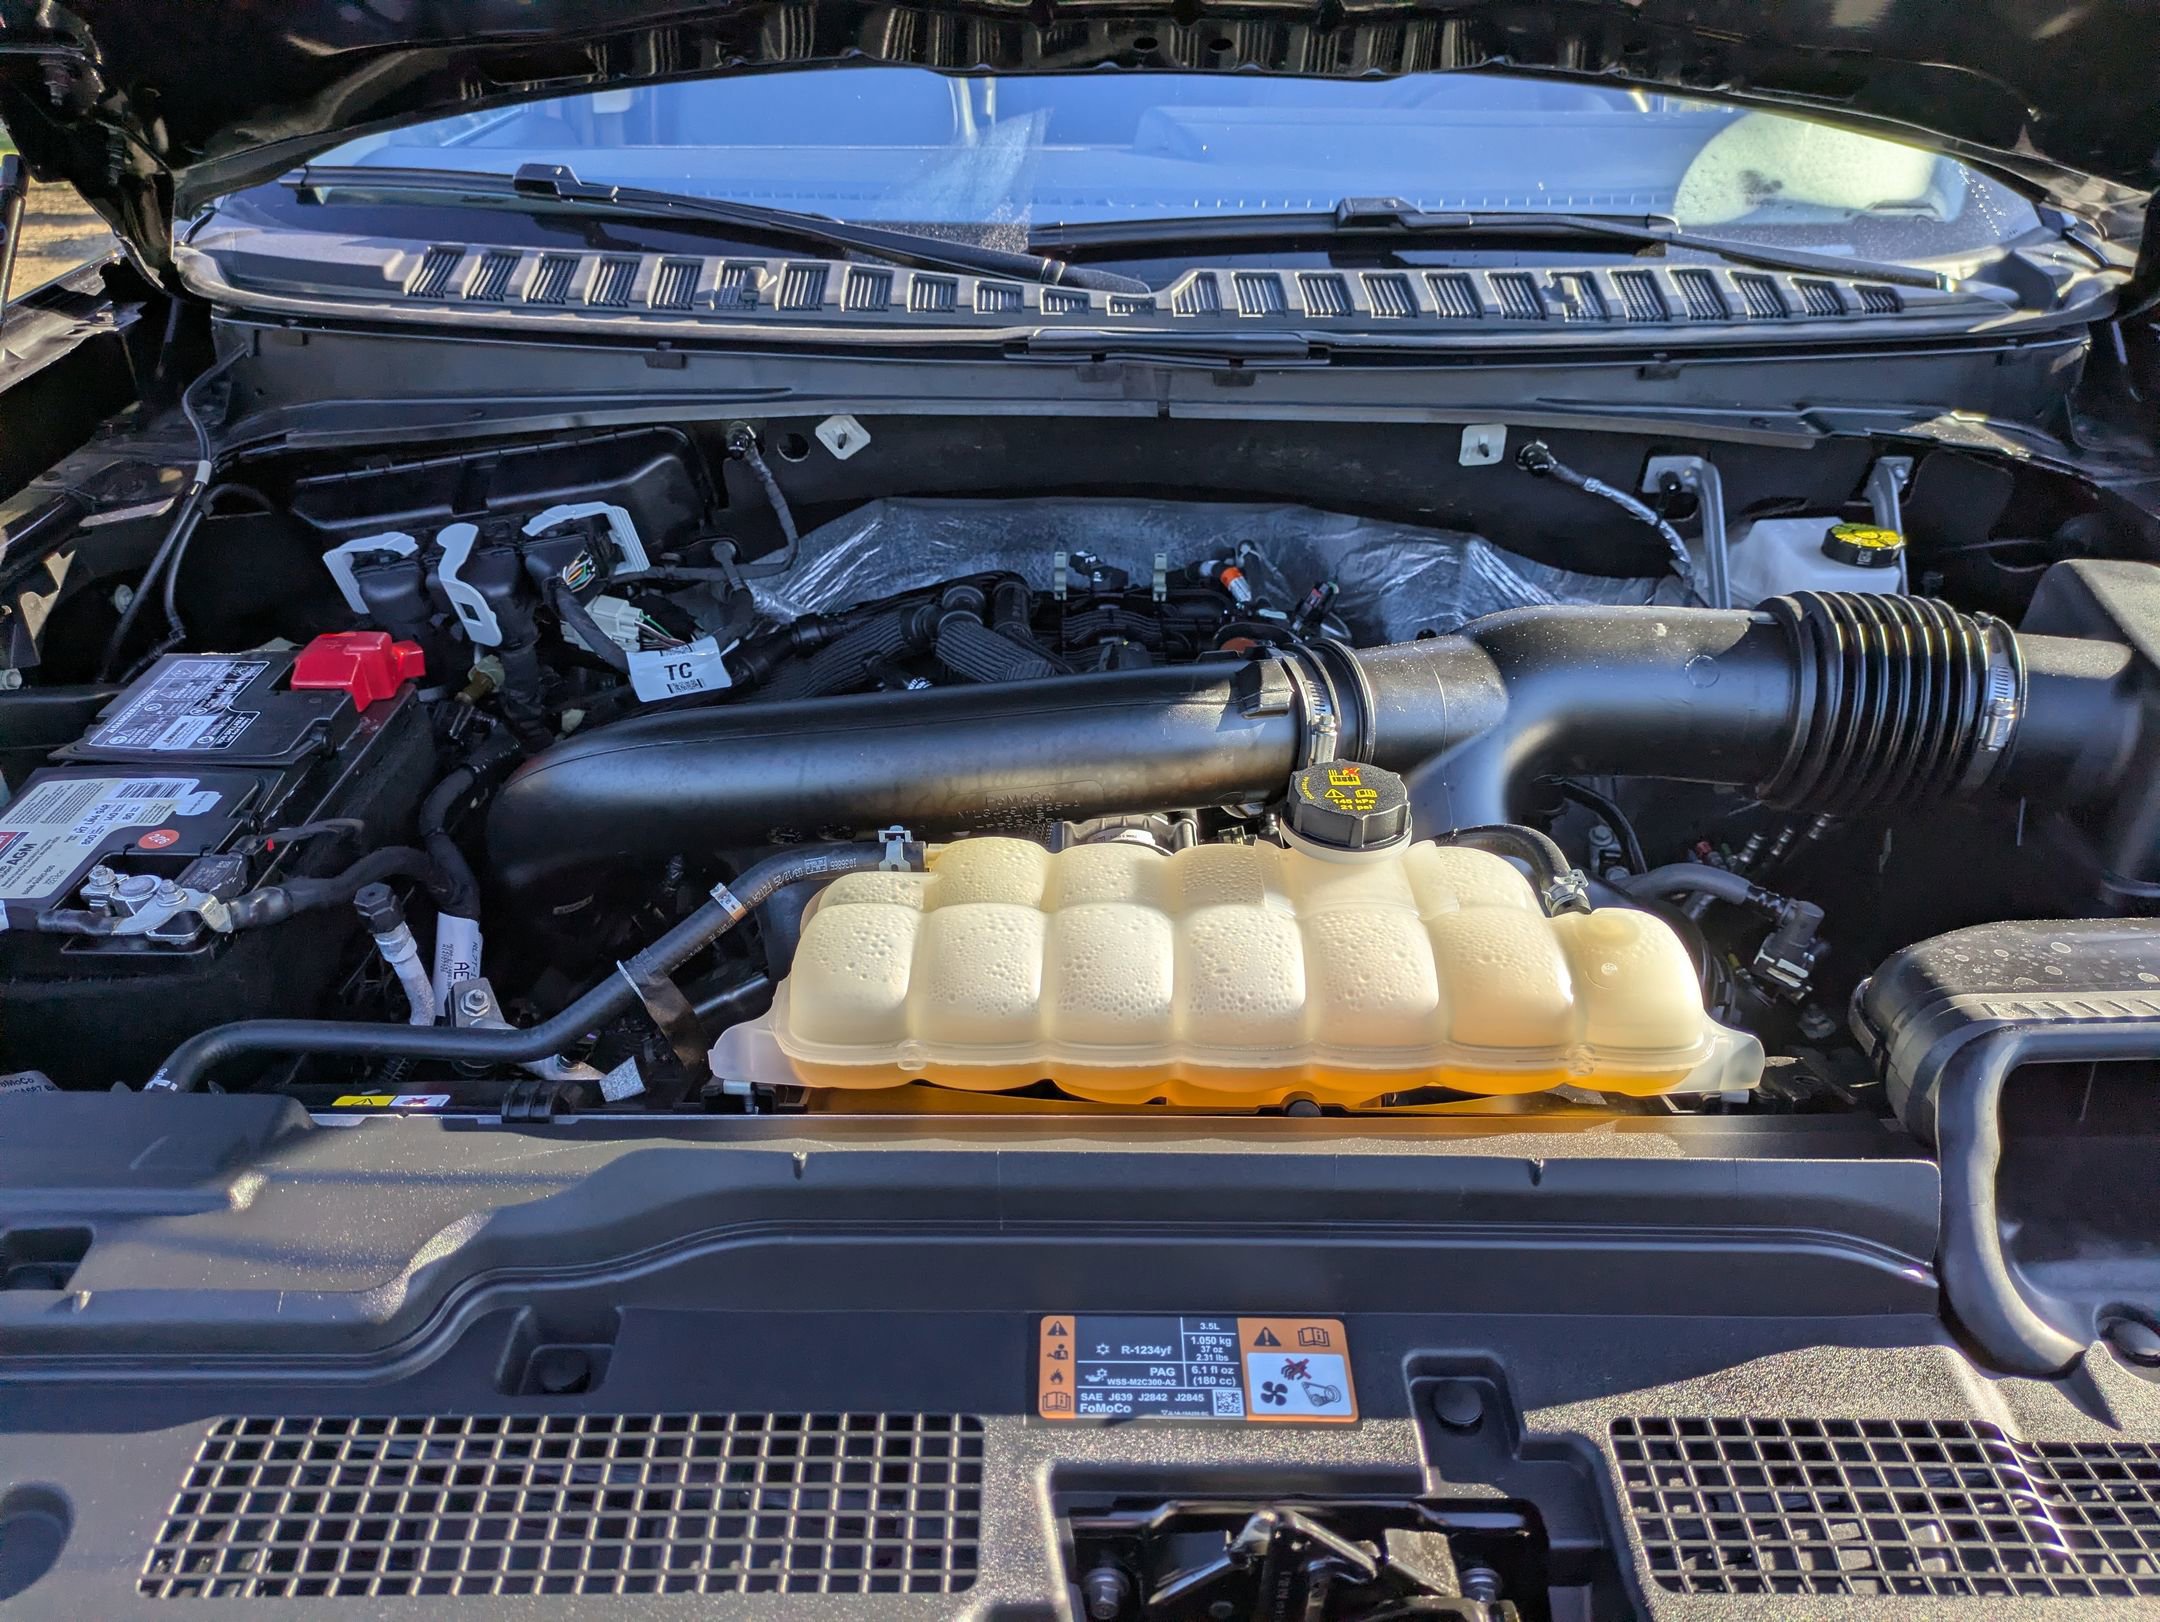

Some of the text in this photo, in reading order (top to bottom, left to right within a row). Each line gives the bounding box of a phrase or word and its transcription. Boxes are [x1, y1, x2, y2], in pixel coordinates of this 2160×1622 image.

[663, 662, 693, 680] TC
[6, 843, 38, 866] AGM
[1199, 1322, 1221, 1331] 3.5L
[1190, 1336, 1232, 1347] 1.050 kg
[1120, 1345, 1173, 1357] R-1234yf
[1149, 1367, 1176, 1377] PAG
[1191, 1366, 1235, 1375] 6.1 fl oz
[1192, 1376, 1237, 1387] (180 cc)
[1080, 1392, 1205, 1402] SAE J639 J2842 J2845
[1080, 1403, 1132, 1413] FoMoCo
